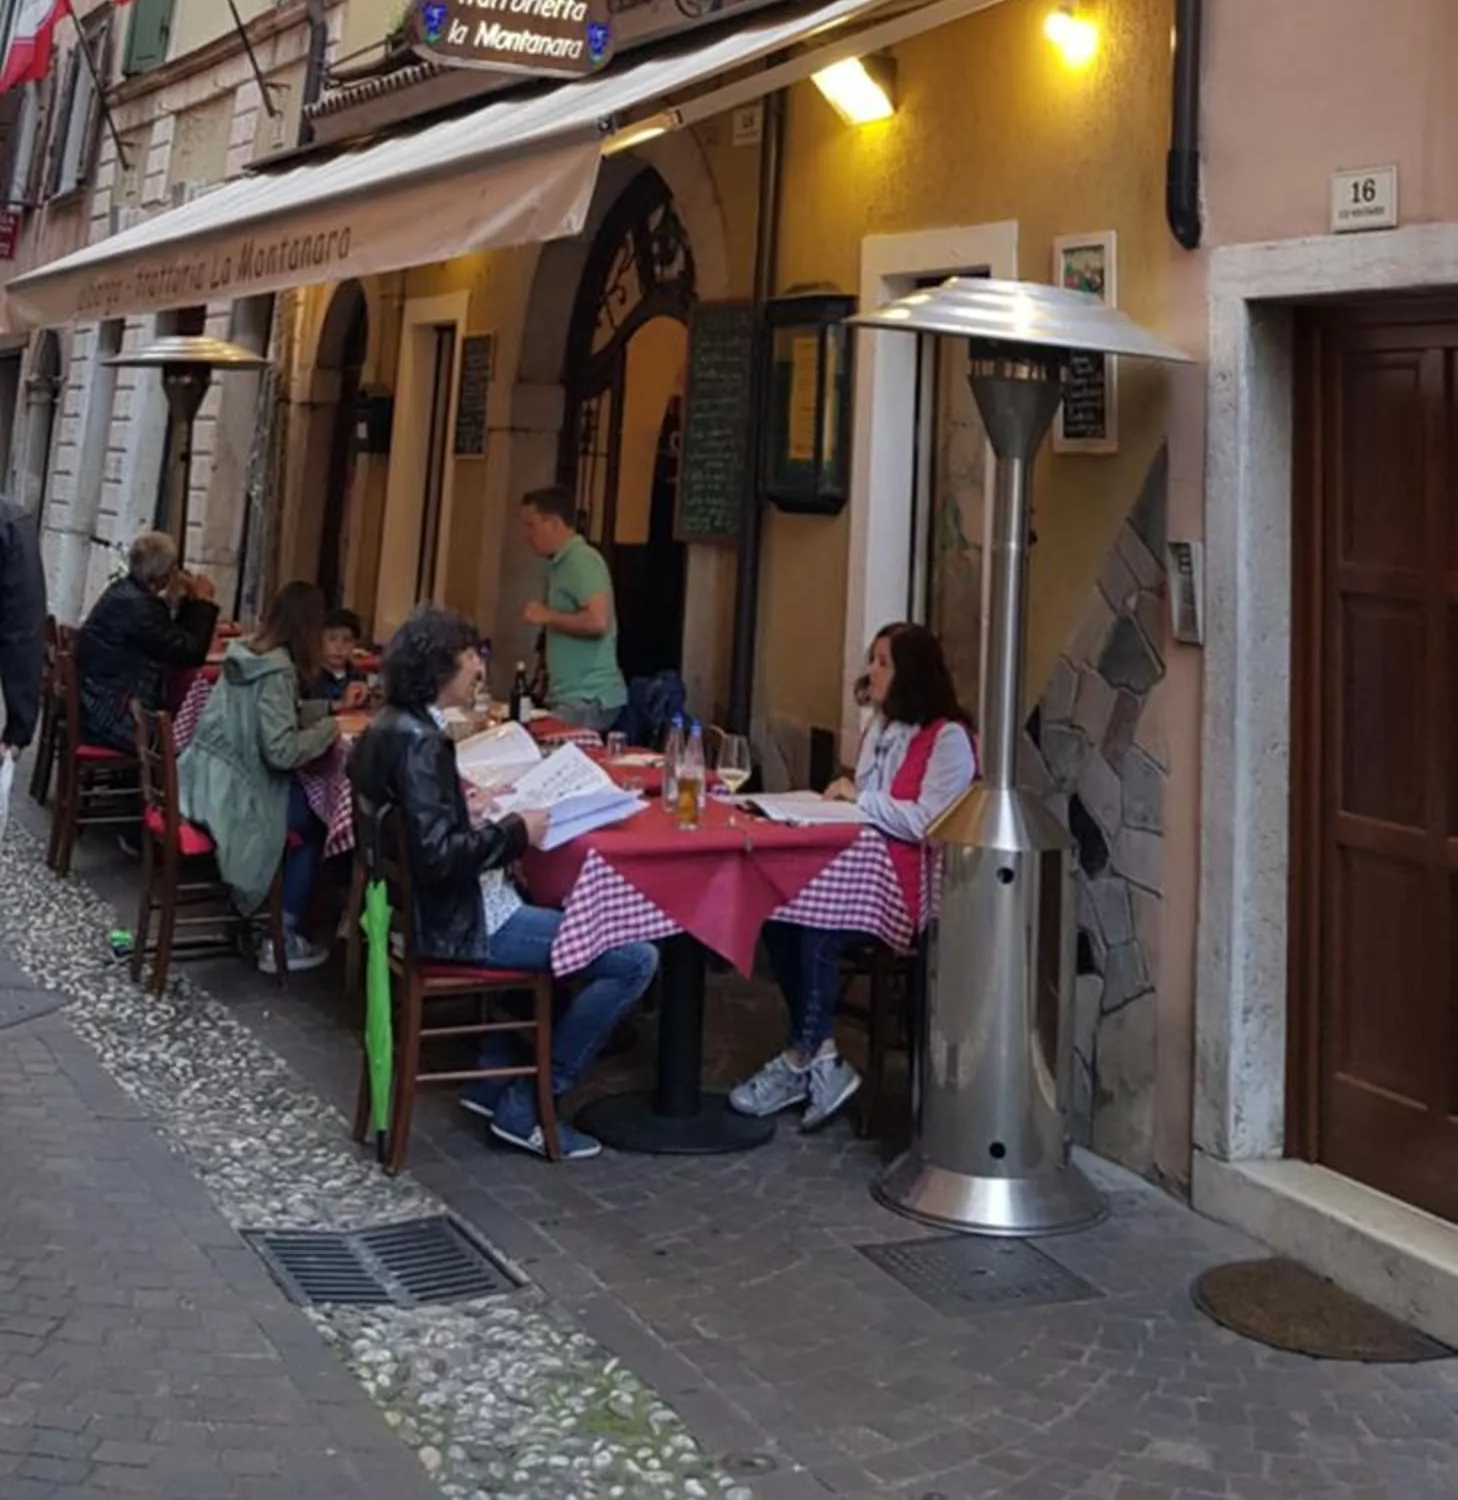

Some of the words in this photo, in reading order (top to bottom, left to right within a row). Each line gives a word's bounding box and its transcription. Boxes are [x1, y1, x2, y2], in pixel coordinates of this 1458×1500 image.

[447, 18, 468, 44] la
[473, 20, 583, 59] Montanara
[1352, 177, 1376, 203] 16
[209, 253, 231, 290] La
[236, 226, 352, 284] Montanara
